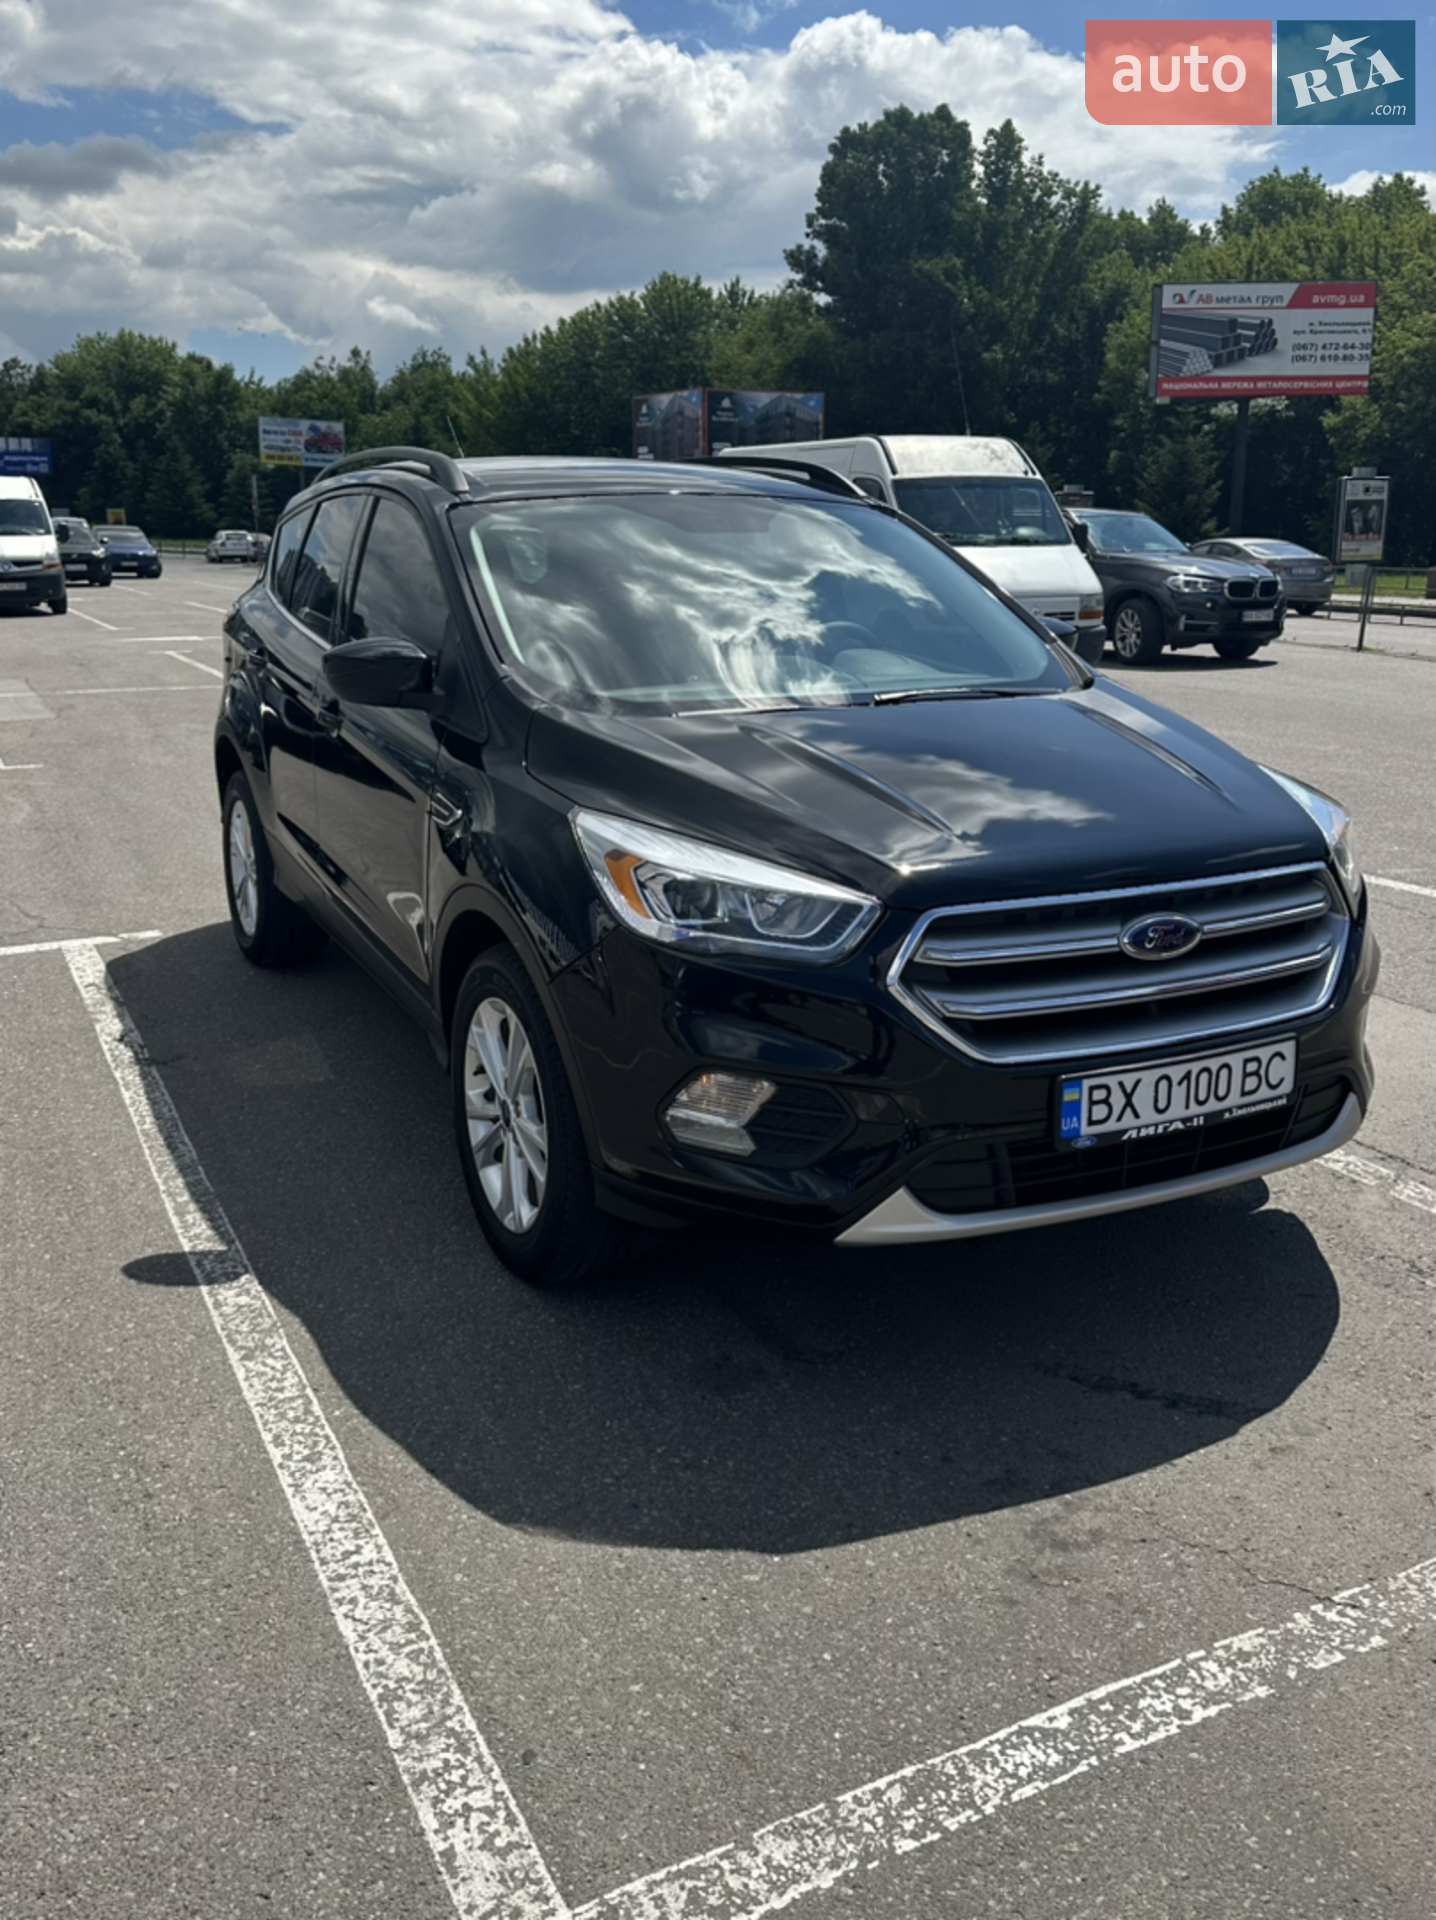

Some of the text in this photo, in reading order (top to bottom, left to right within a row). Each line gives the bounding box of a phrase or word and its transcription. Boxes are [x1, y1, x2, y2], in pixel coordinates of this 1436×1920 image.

[1215, 295, 1252, 304] метал
[1256, 294, 1284, 306] груп
[1311, 294, 1365, 306] avmg.ua
[1291, 342, 1371, 352] (067) 472-64-30
[1291, 354, 1317, 364] (067)
[1221, 381, 1254, 390] МЕРЕЖА
[1153, 1061, 1233, 1115] 0100
[1062, 1117, 1079, 1131] UA
